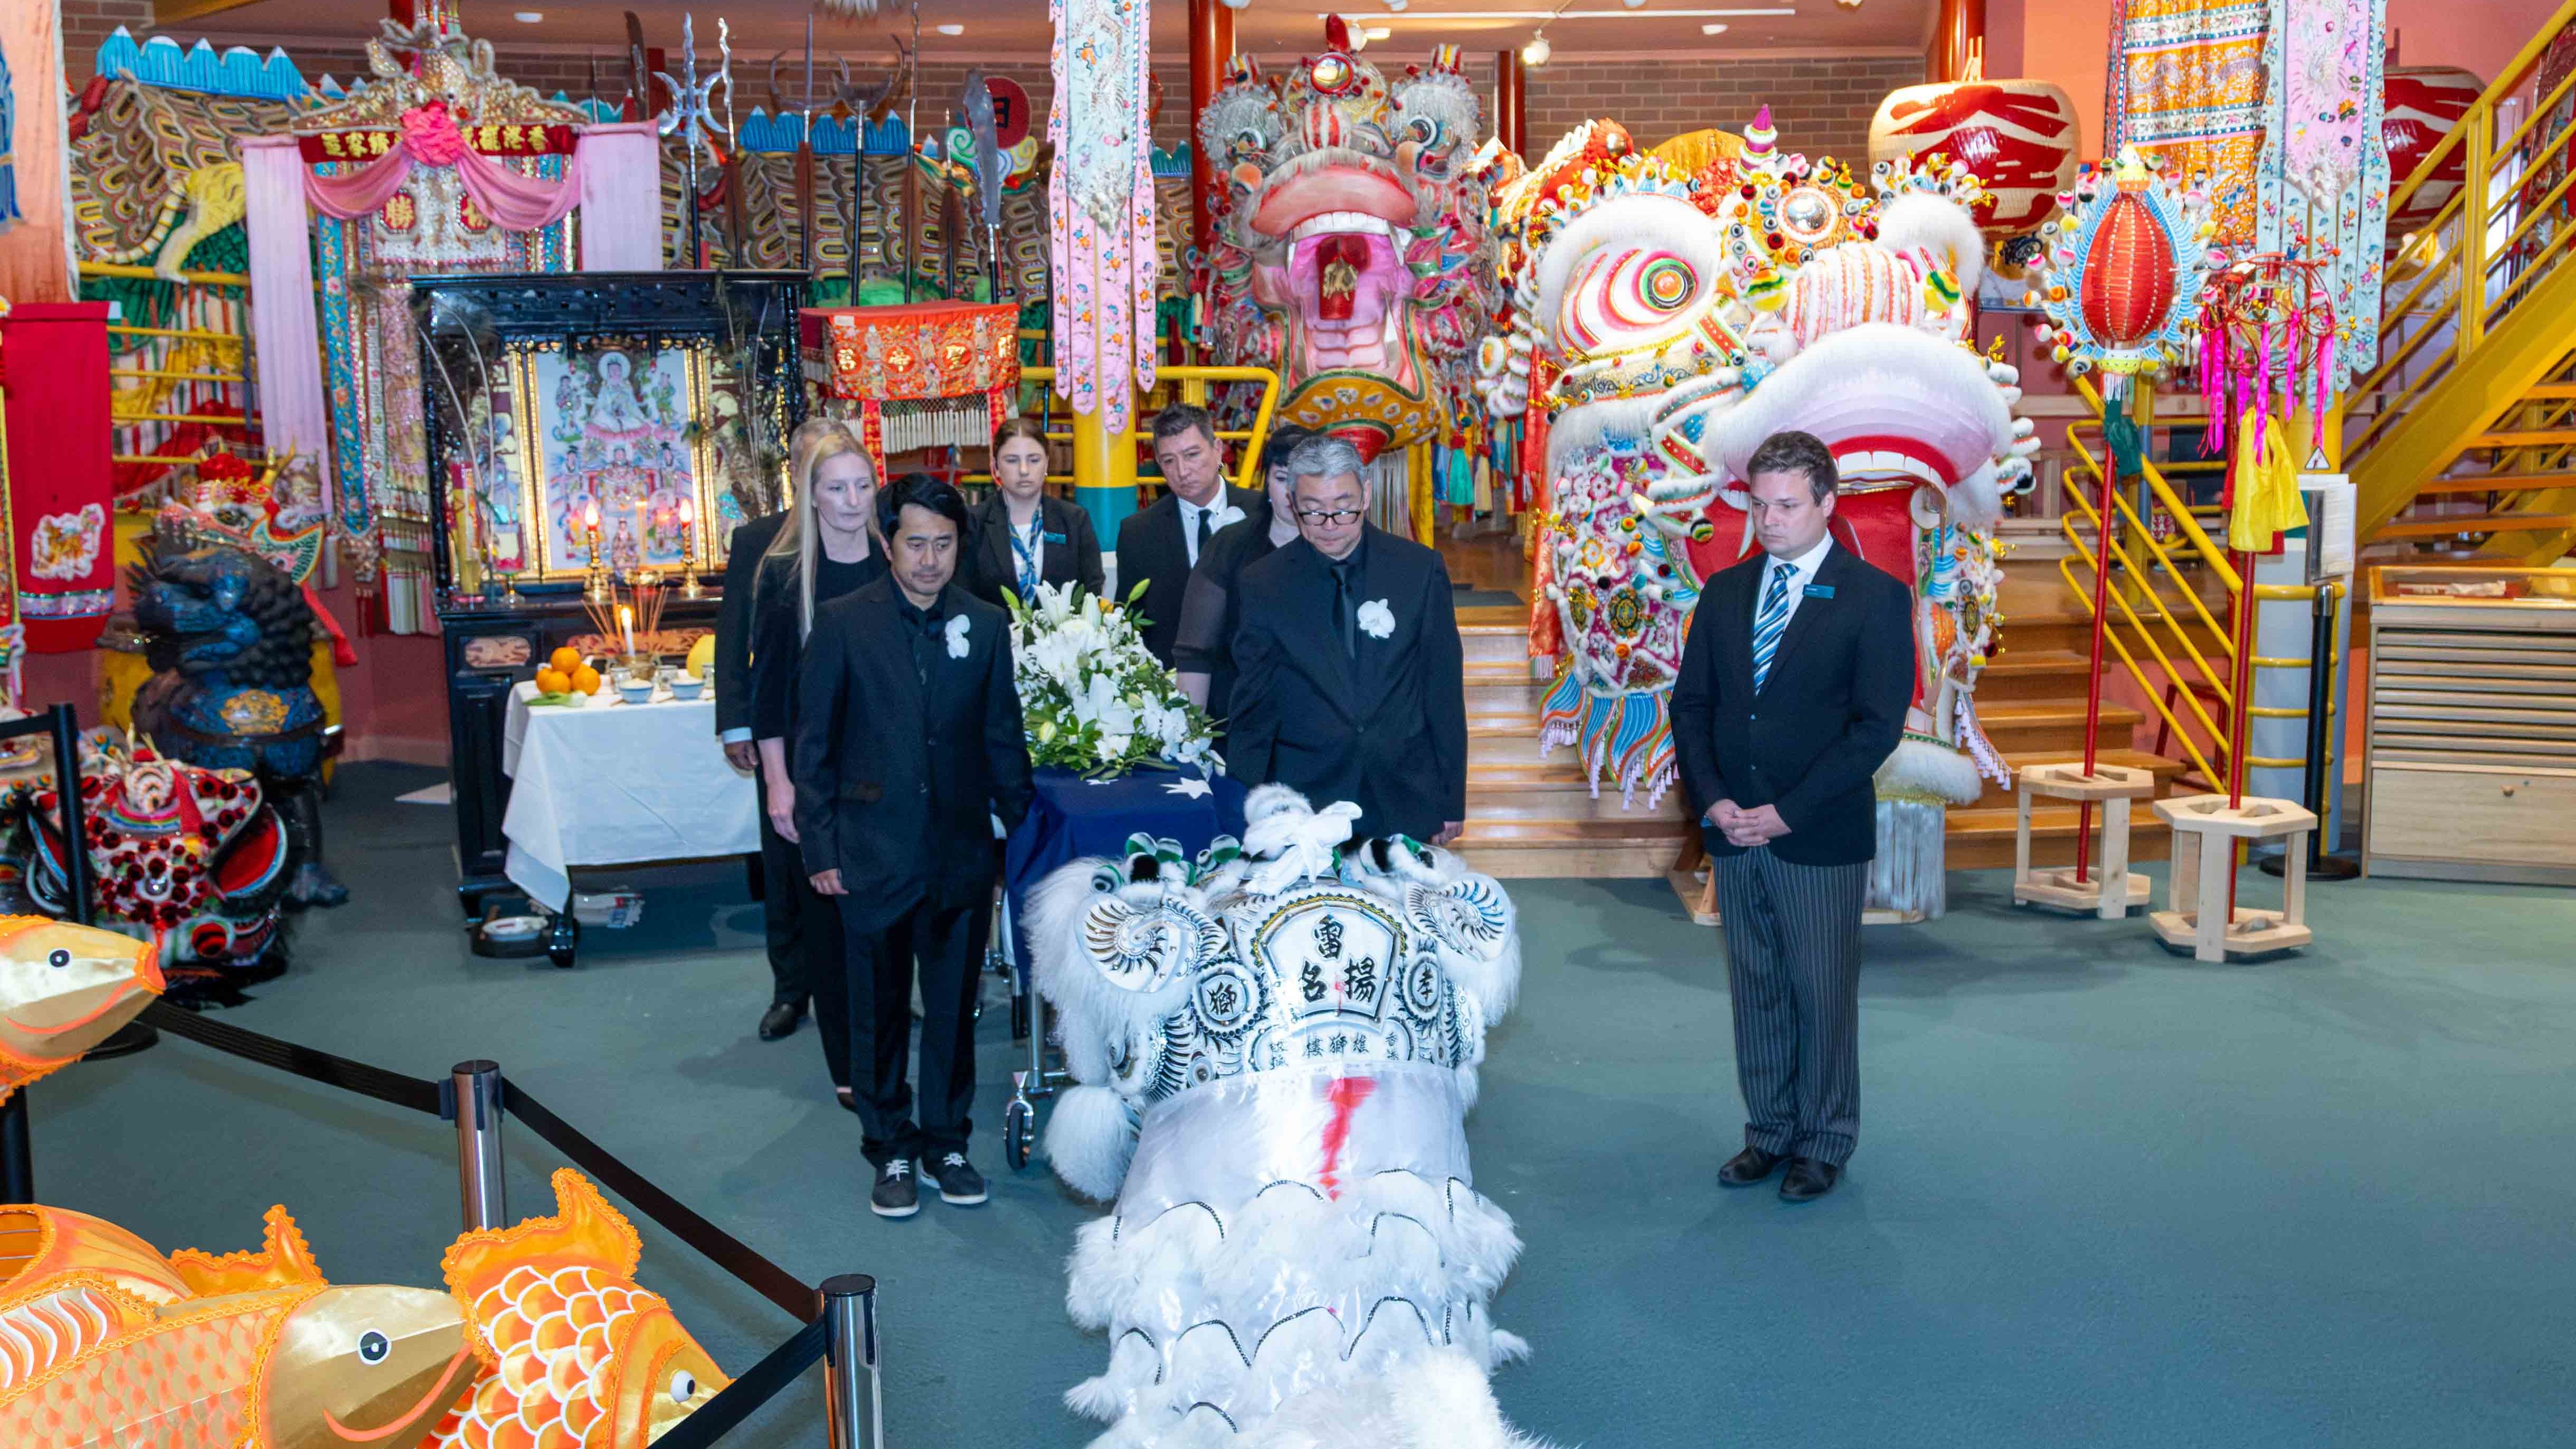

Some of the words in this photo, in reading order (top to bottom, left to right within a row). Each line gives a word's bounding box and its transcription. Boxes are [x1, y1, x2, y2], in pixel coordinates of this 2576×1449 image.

[1314, 915, 1343, 959] 雷
[1207, 981, 1237, 1015] 獅
[1418, 965, 1434, 1000] 孝
